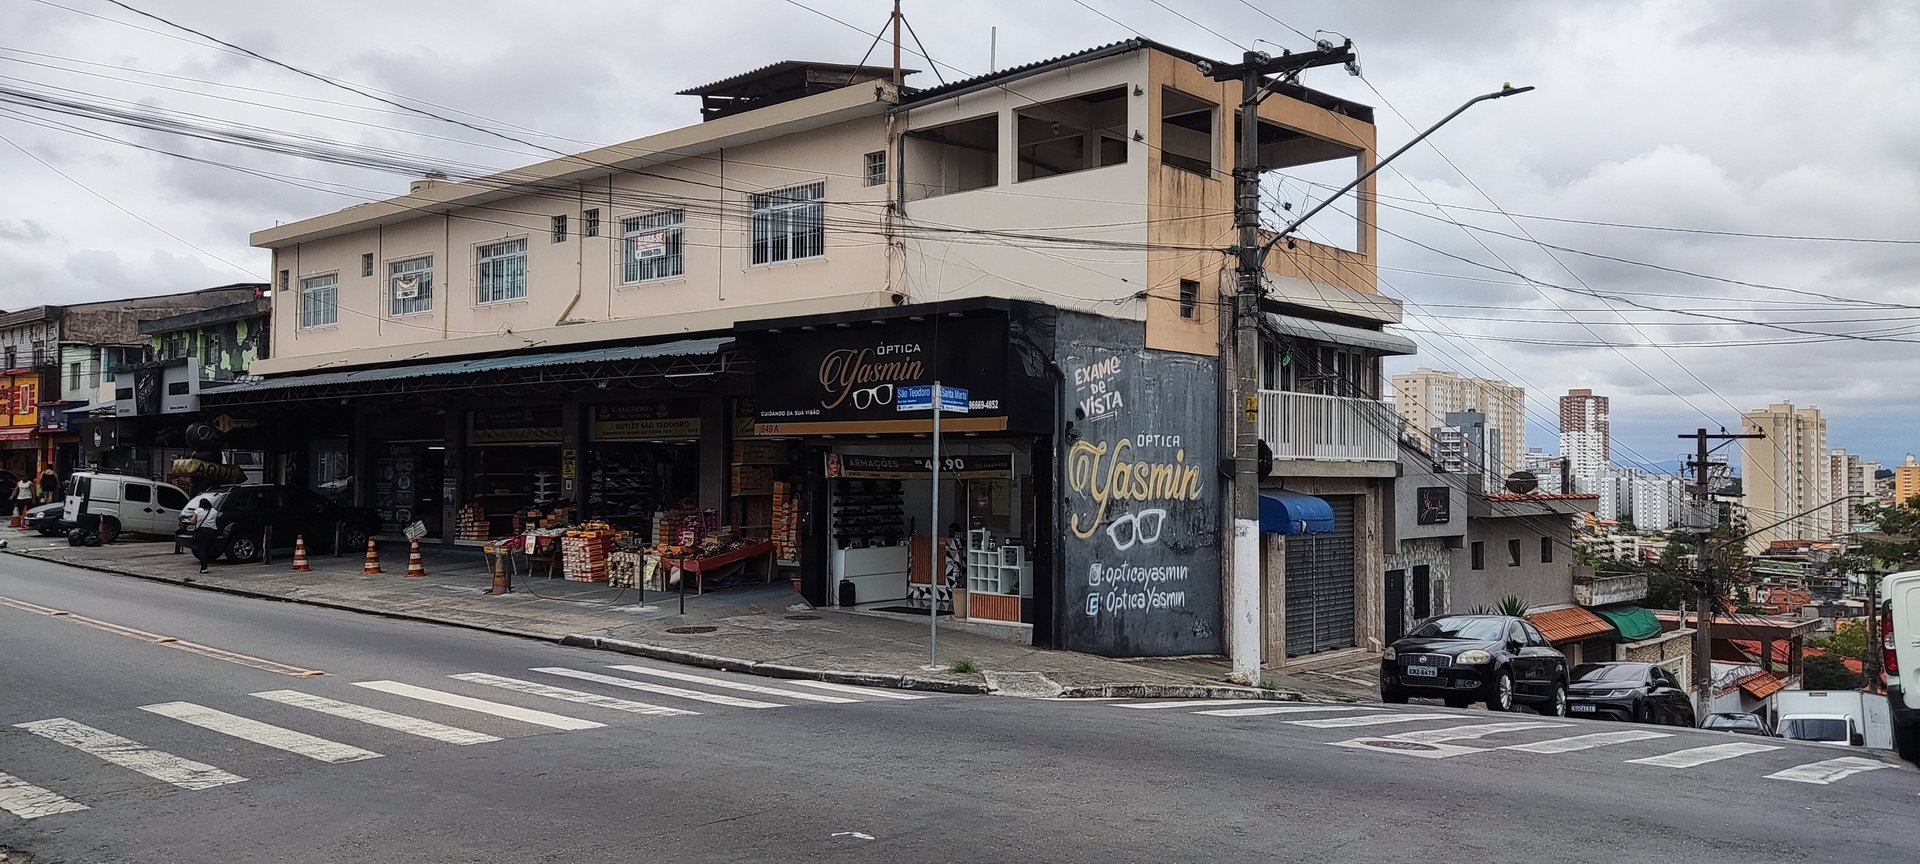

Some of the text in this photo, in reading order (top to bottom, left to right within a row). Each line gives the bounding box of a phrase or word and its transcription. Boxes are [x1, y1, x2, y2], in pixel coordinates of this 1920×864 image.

[877, 341, 921, 355] ÓPTICA
[819, 348, 925, 409] Yasmin
[898, 387, 931, 399] São Teodoro
[941, 388, 954, 399] Santa
[969, 400, 999, 410] 96669-4852
[616, 420, 690, 431] OUTLET SÃO TEODORO
[761, 424, 773, 433] 649
[1137, 431, 1181, 447] ÓPTICA
[196, 462, 232, 481] AQUI
[848, 457, 900, 470] ARMAÇÕES
[924, 458, 965, 472] 4,90
[1068, 438, 1205, 539] Yasmin
